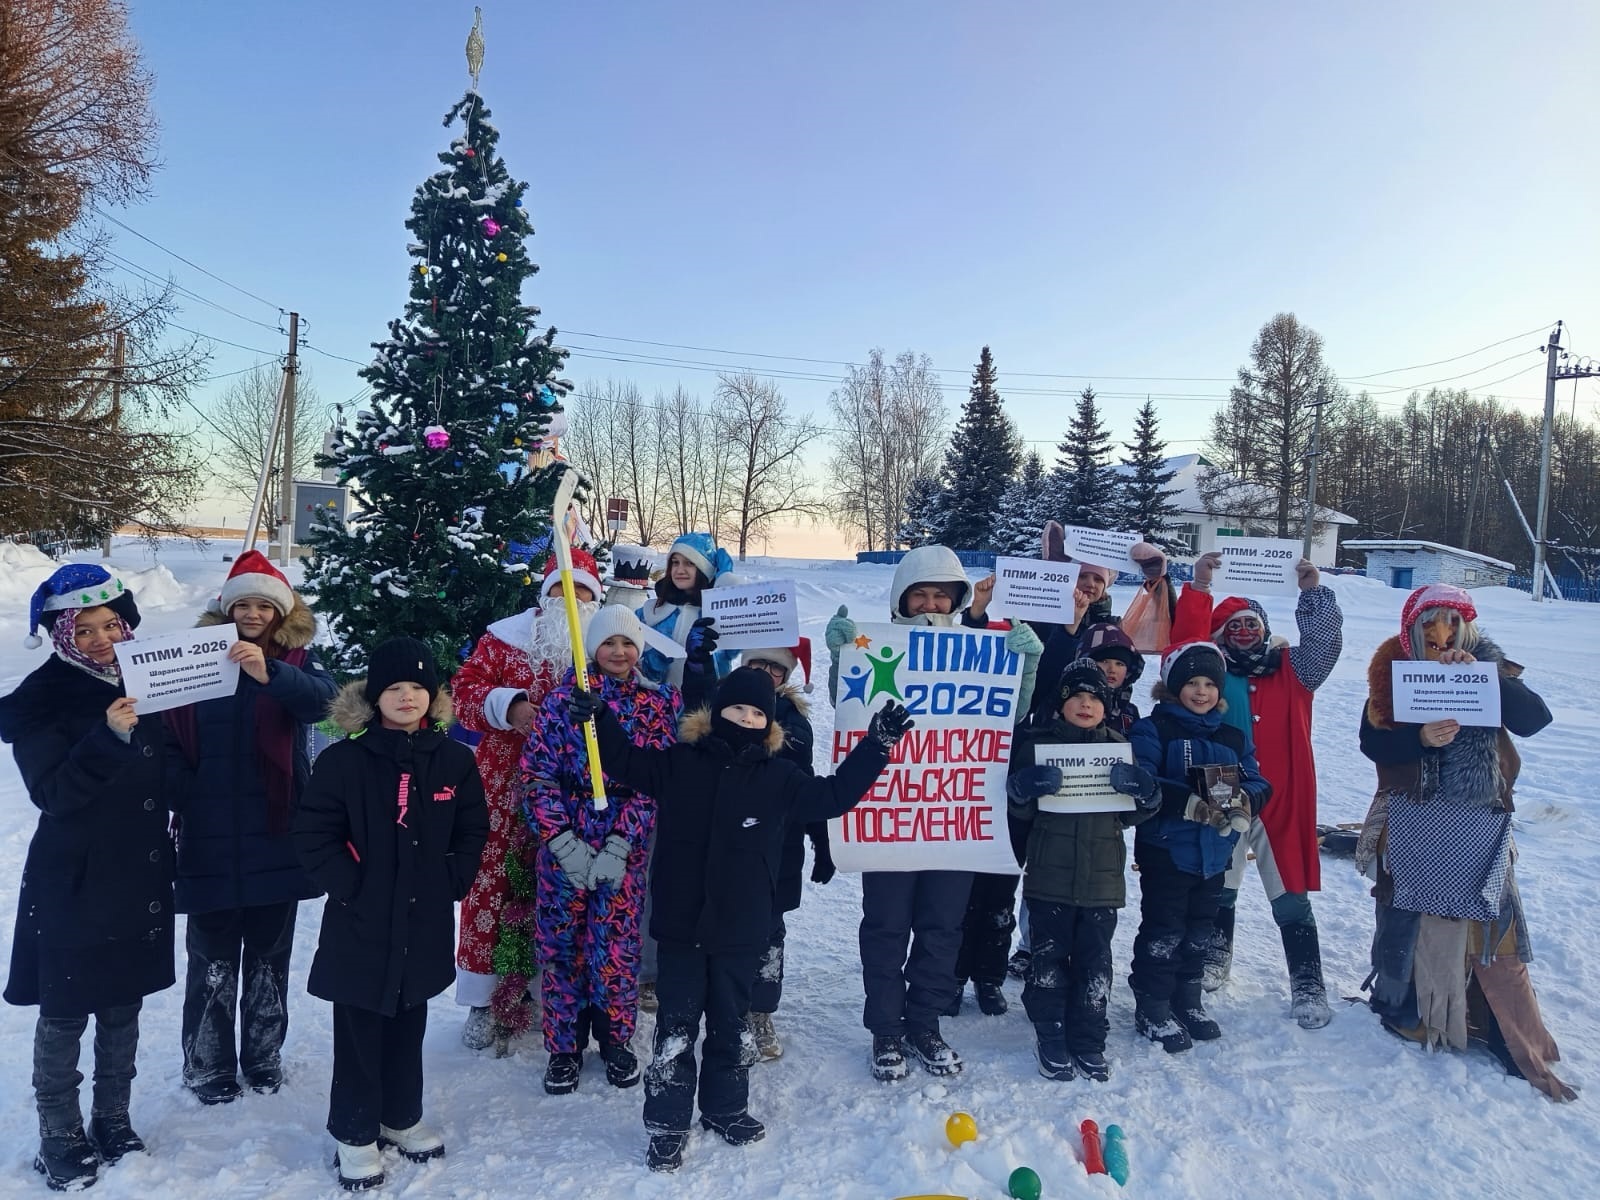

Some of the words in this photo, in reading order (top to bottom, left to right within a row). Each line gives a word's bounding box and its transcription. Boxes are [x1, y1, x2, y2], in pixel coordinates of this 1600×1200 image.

[1222, 547, 1258, 557] ППМИ
[1260, 549, 1293, 559] -2026
[1002, 569, 1037, 580] ППМИ
[1040, 572, 1070, 583] -2026
[711, 597, 748, 610] ППМИ
[752, 593, 787, 605] -2026
[131, 647, 184, 665] ППМИ
[187, 640, 228, 657] -2026
[908, 631, 1020, 676] ППМИ
[1402, 674, 1446, 684] ППМИ
[1449, 674, 1489, 684] -2026
[904, 682, 1014, 717] 2026
[1045, 758, 1086, 768] ППМИ
[398, 773, 411, 806] PUMA
[860, 768, 987, 802] ЕЛЬСКОЕ
[843, 806, 994, 843] ПОСЕЛЕНИЕ
